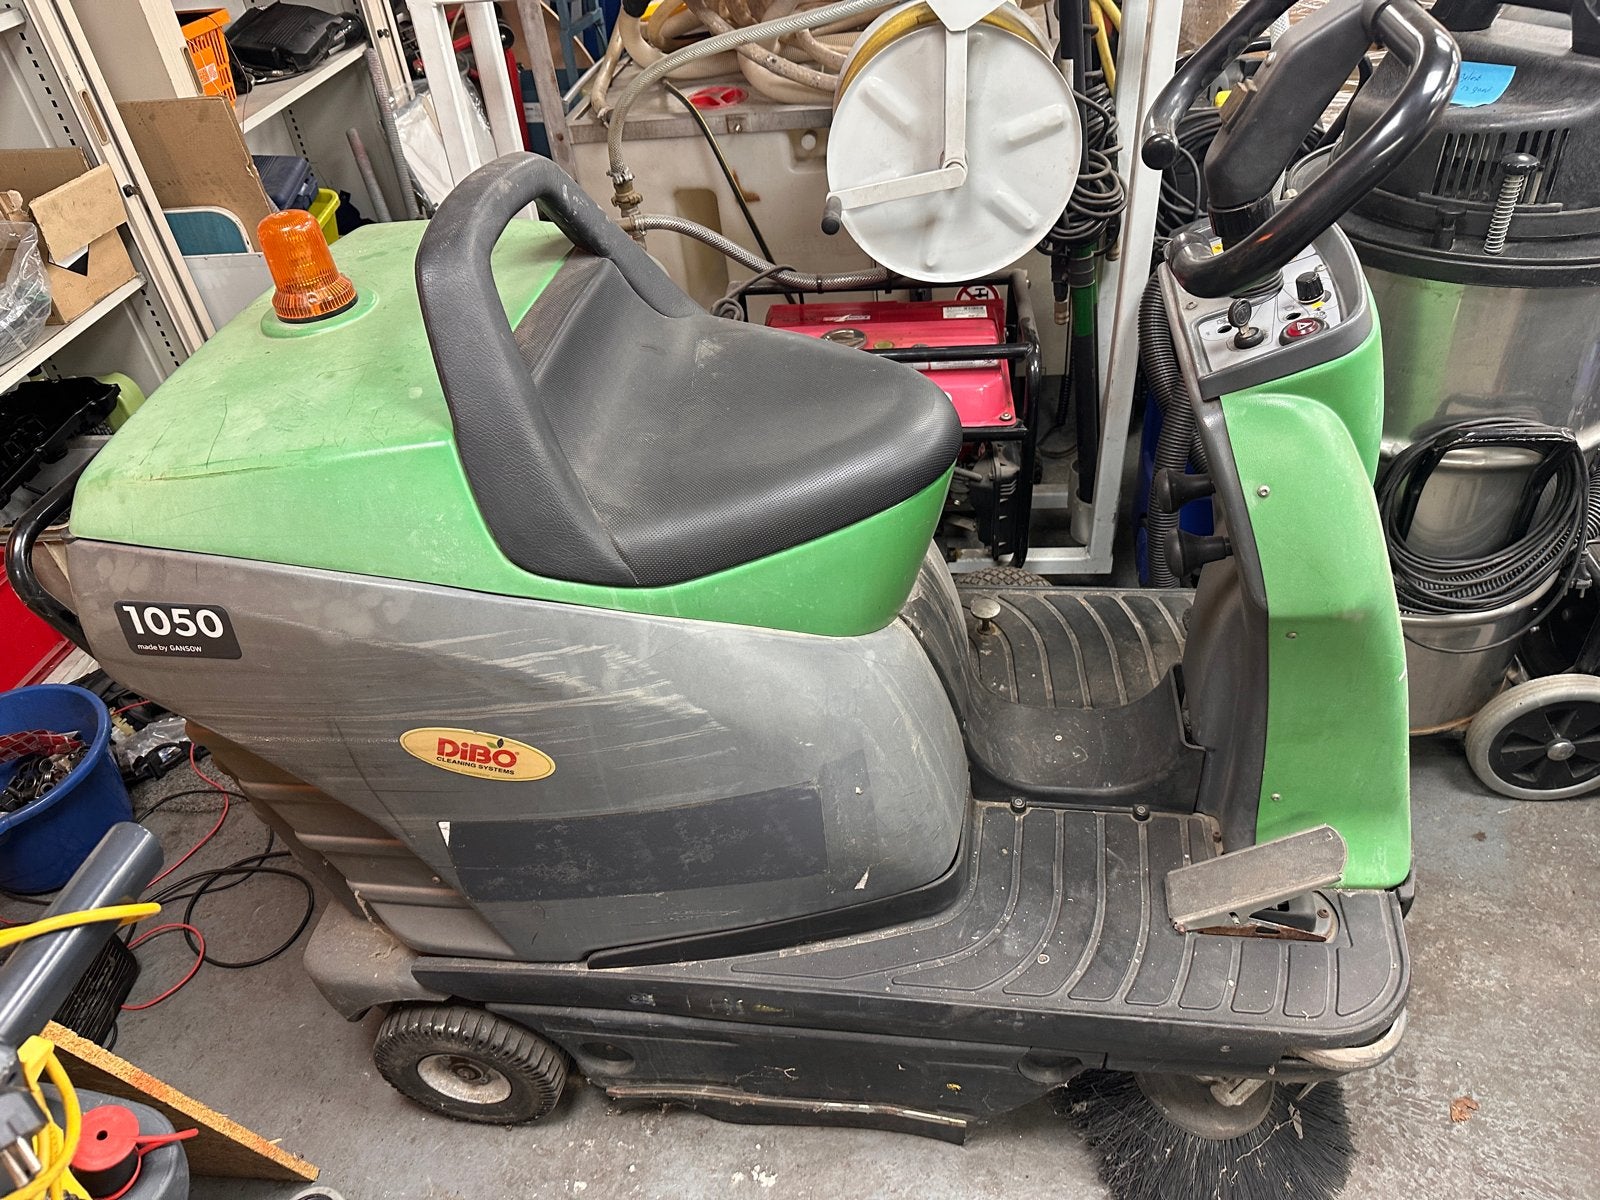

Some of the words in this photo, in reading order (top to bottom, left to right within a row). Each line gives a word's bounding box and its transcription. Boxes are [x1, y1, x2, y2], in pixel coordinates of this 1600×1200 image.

[122, 605, 224, 638] 1050
[158, 644, 168, 653] by
[169, 645, 202, 653] GANSOW
[436, 756, 477, 768] CLEANING
[478, 764, 515, 774] SYSTEMS
